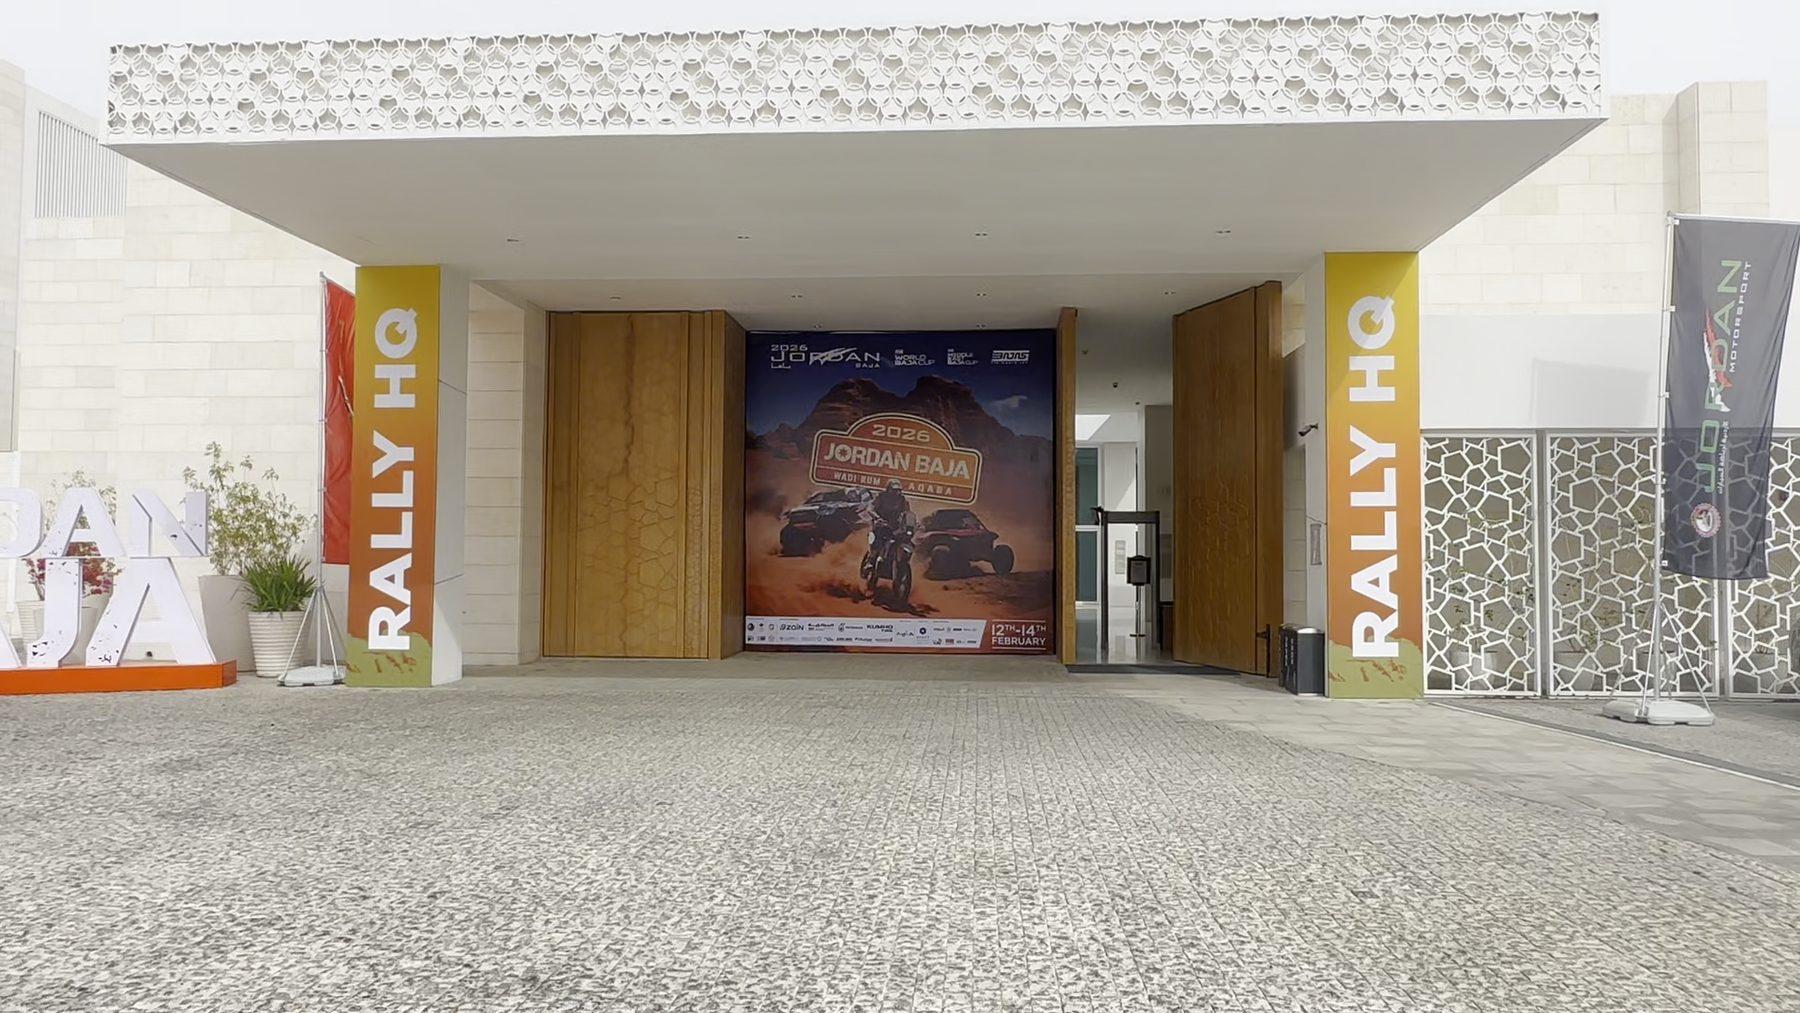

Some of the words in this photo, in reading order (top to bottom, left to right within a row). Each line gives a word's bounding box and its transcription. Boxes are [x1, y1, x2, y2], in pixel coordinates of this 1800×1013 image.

[374, 307, 418, 409] HQ
[770, 344, 808, 352] 2026
[770, 350, 880, 364] JORDAN
[1347, 296, 1396, 402] HQ
[1729, 261, 1752, 373] MOTORSPORT
[1696, 260, 1742, 494] JORDAN
[824, 442, 911, 471] JORDAN
[915, 455, 970, 480] BAJA
[834, 472, 857, 483] WADI
[861, 476, 881, 486] RUM
[908, 482, 953, 496] AQABA
[872, 424, 931, 442] 2026
[367, 430, 415, 651] RALLY
[1348, 425, 1400, 659] RALLY
[0, 557, 217, 668] JA
[991, 636, 1047, 645] FEBRUARY
